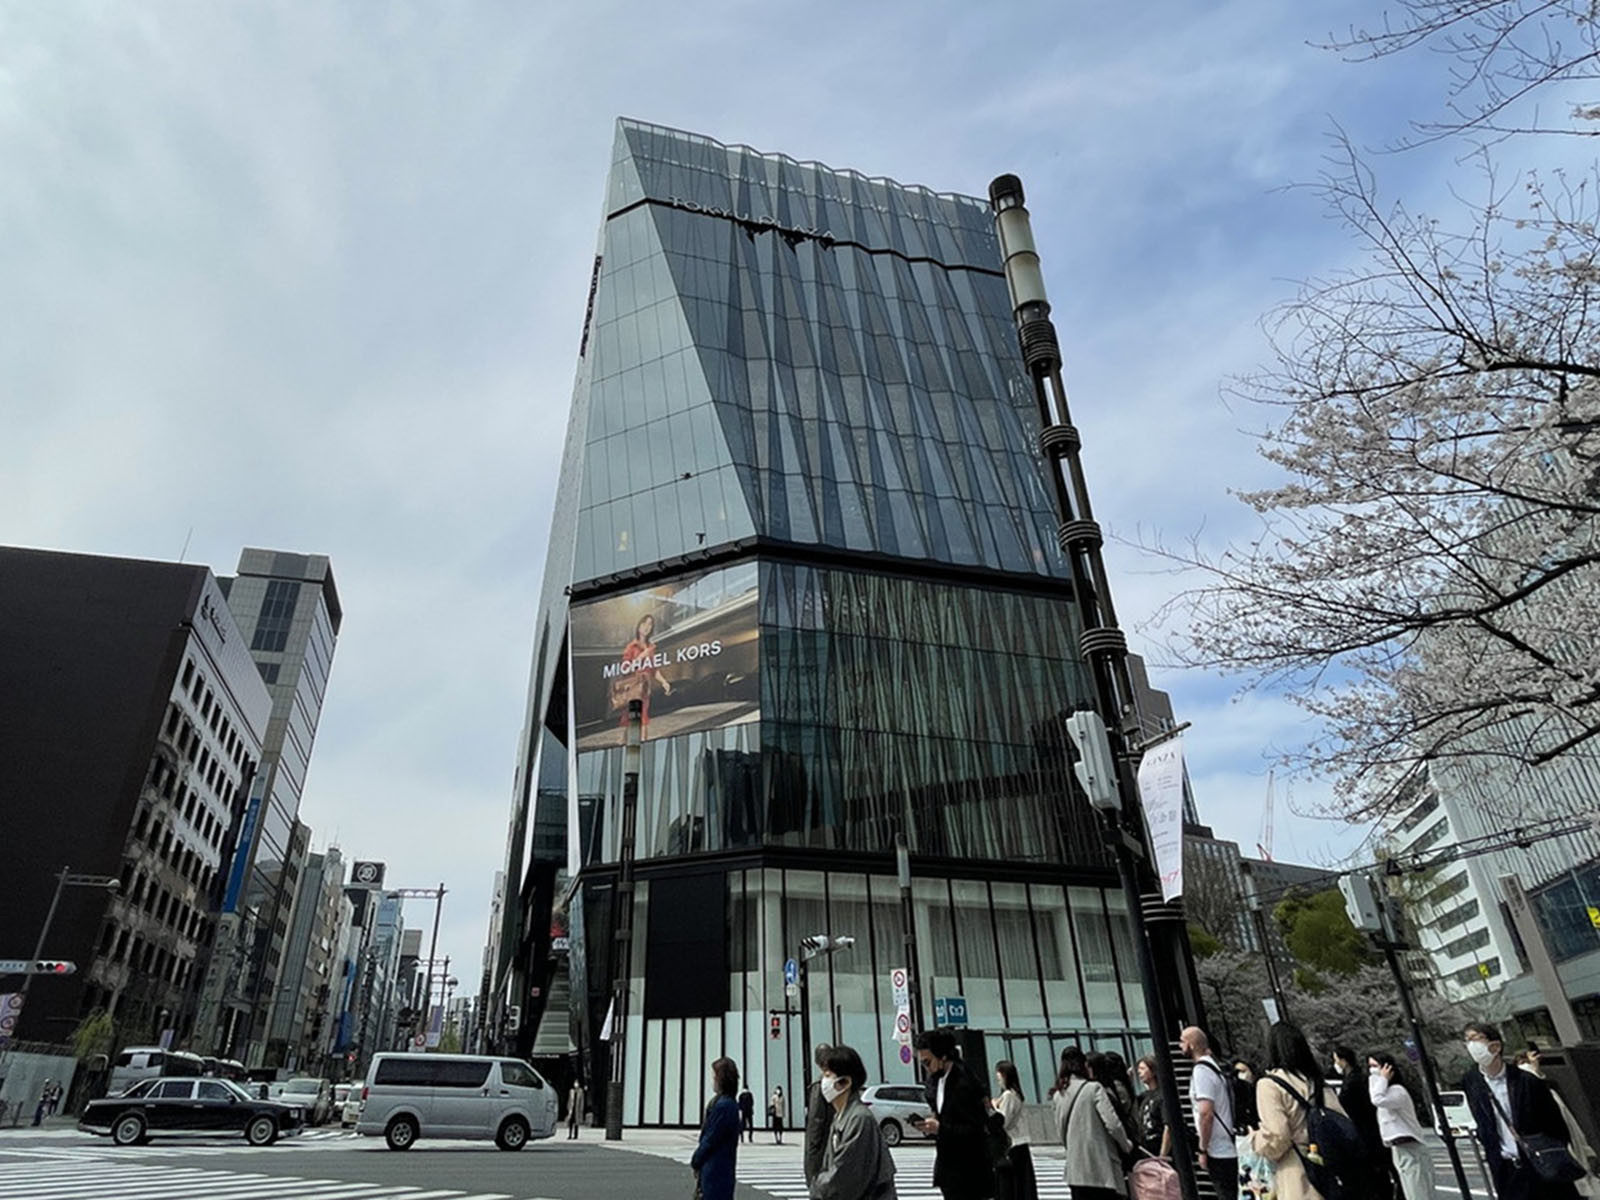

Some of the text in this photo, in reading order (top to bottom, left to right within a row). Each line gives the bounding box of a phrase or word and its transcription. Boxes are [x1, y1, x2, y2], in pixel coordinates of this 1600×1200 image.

[668, 195, 749, 221] TOKYU
[602, 640, 722, 679] MICHAEL KORS
